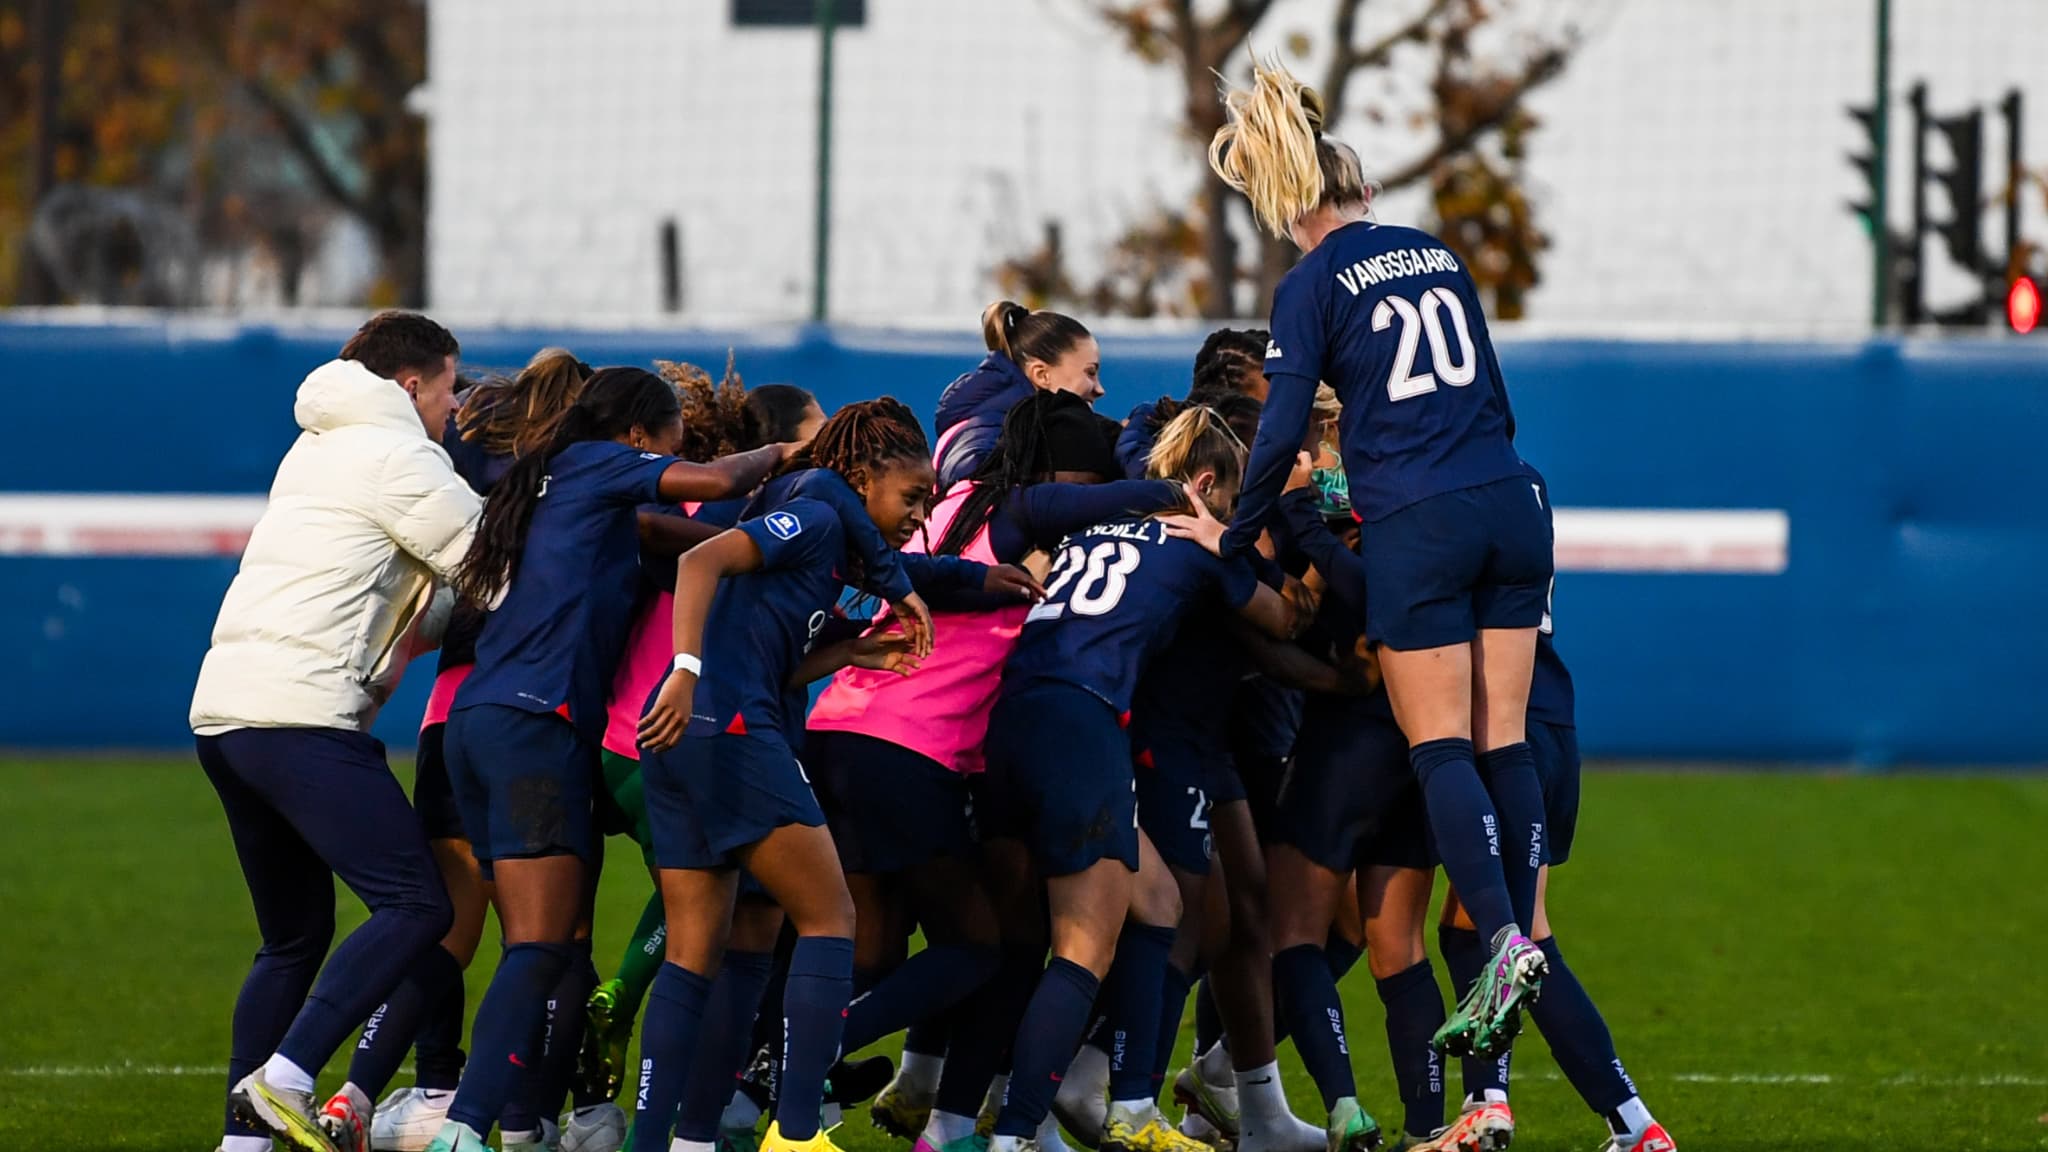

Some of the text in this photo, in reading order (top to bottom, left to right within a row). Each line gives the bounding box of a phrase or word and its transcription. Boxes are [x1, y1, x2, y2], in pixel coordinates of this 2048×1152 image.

[1336, 248, 1459, 296] VANGSGAARD
[1371, 287, 1476, 402] 20
[1024, 542, 1141, 624] 28
[1187, 786, 1213, 829] 2
[1482, 814, 1500, 856] PARIS
[1528, 823, 1542, 869] PARIS
[643, 924, 667, 955] ARIS
[358, 1003, 388, 1049] PARIS
[1327, 1008, 1348, 1054] PARIS
[1112, 1031, 1127, 1071] PARIS
[1427, 1041, 1441, 1093] ARIS
[1497, 1050, 1510, 1084] PAR
[636, 1058, 653, 1111] PARIS
